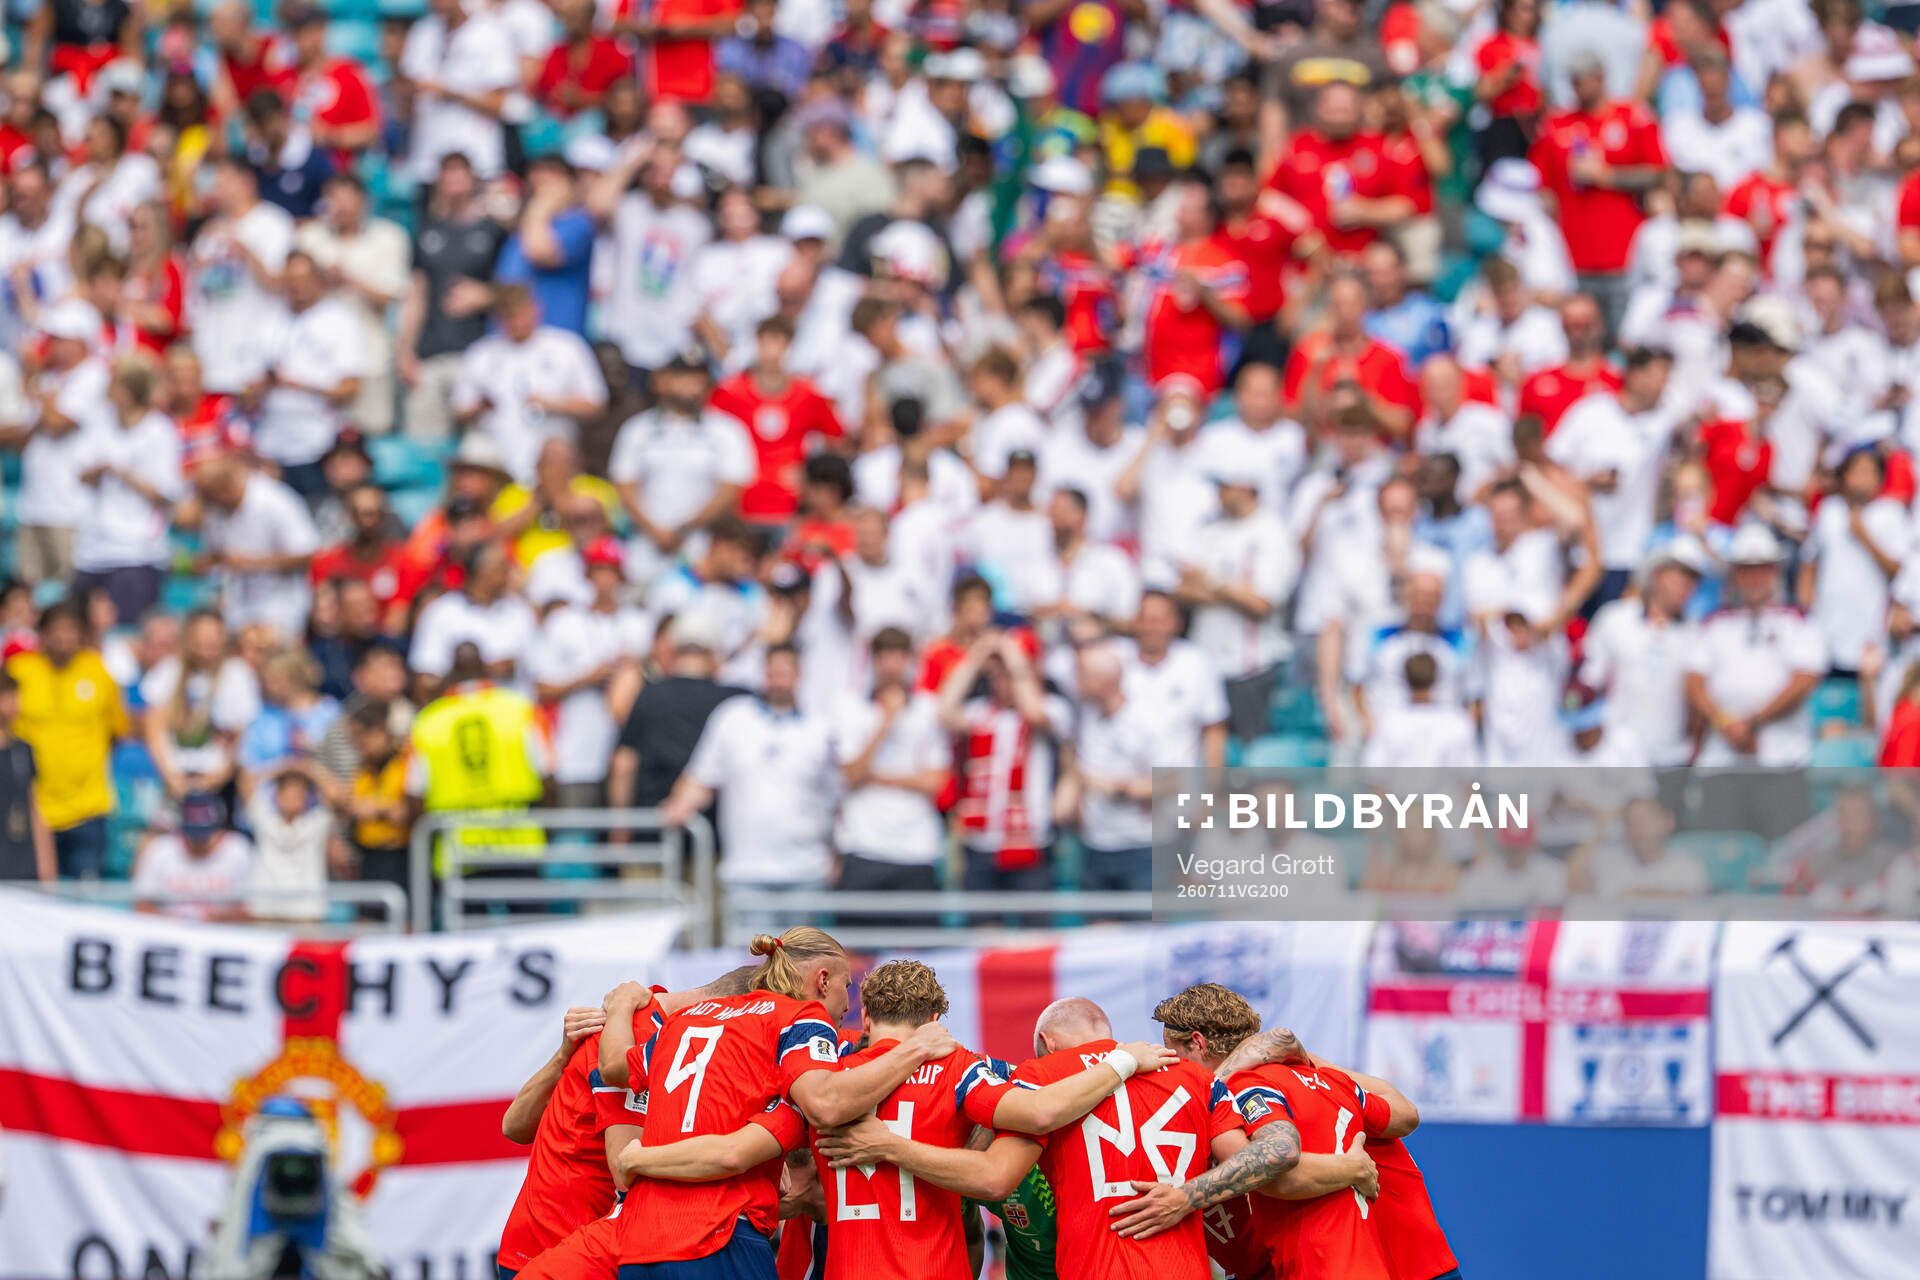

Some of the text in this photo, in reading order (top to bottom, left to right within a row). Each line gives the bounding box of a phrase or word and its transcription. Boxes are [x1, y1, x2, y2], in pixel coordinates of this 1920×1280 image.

[663, 1024, 725, 1134] 9
[1081, 1081, 1197, 1203] 26
[1733, 1184, 1909, 1227] TOMMY
